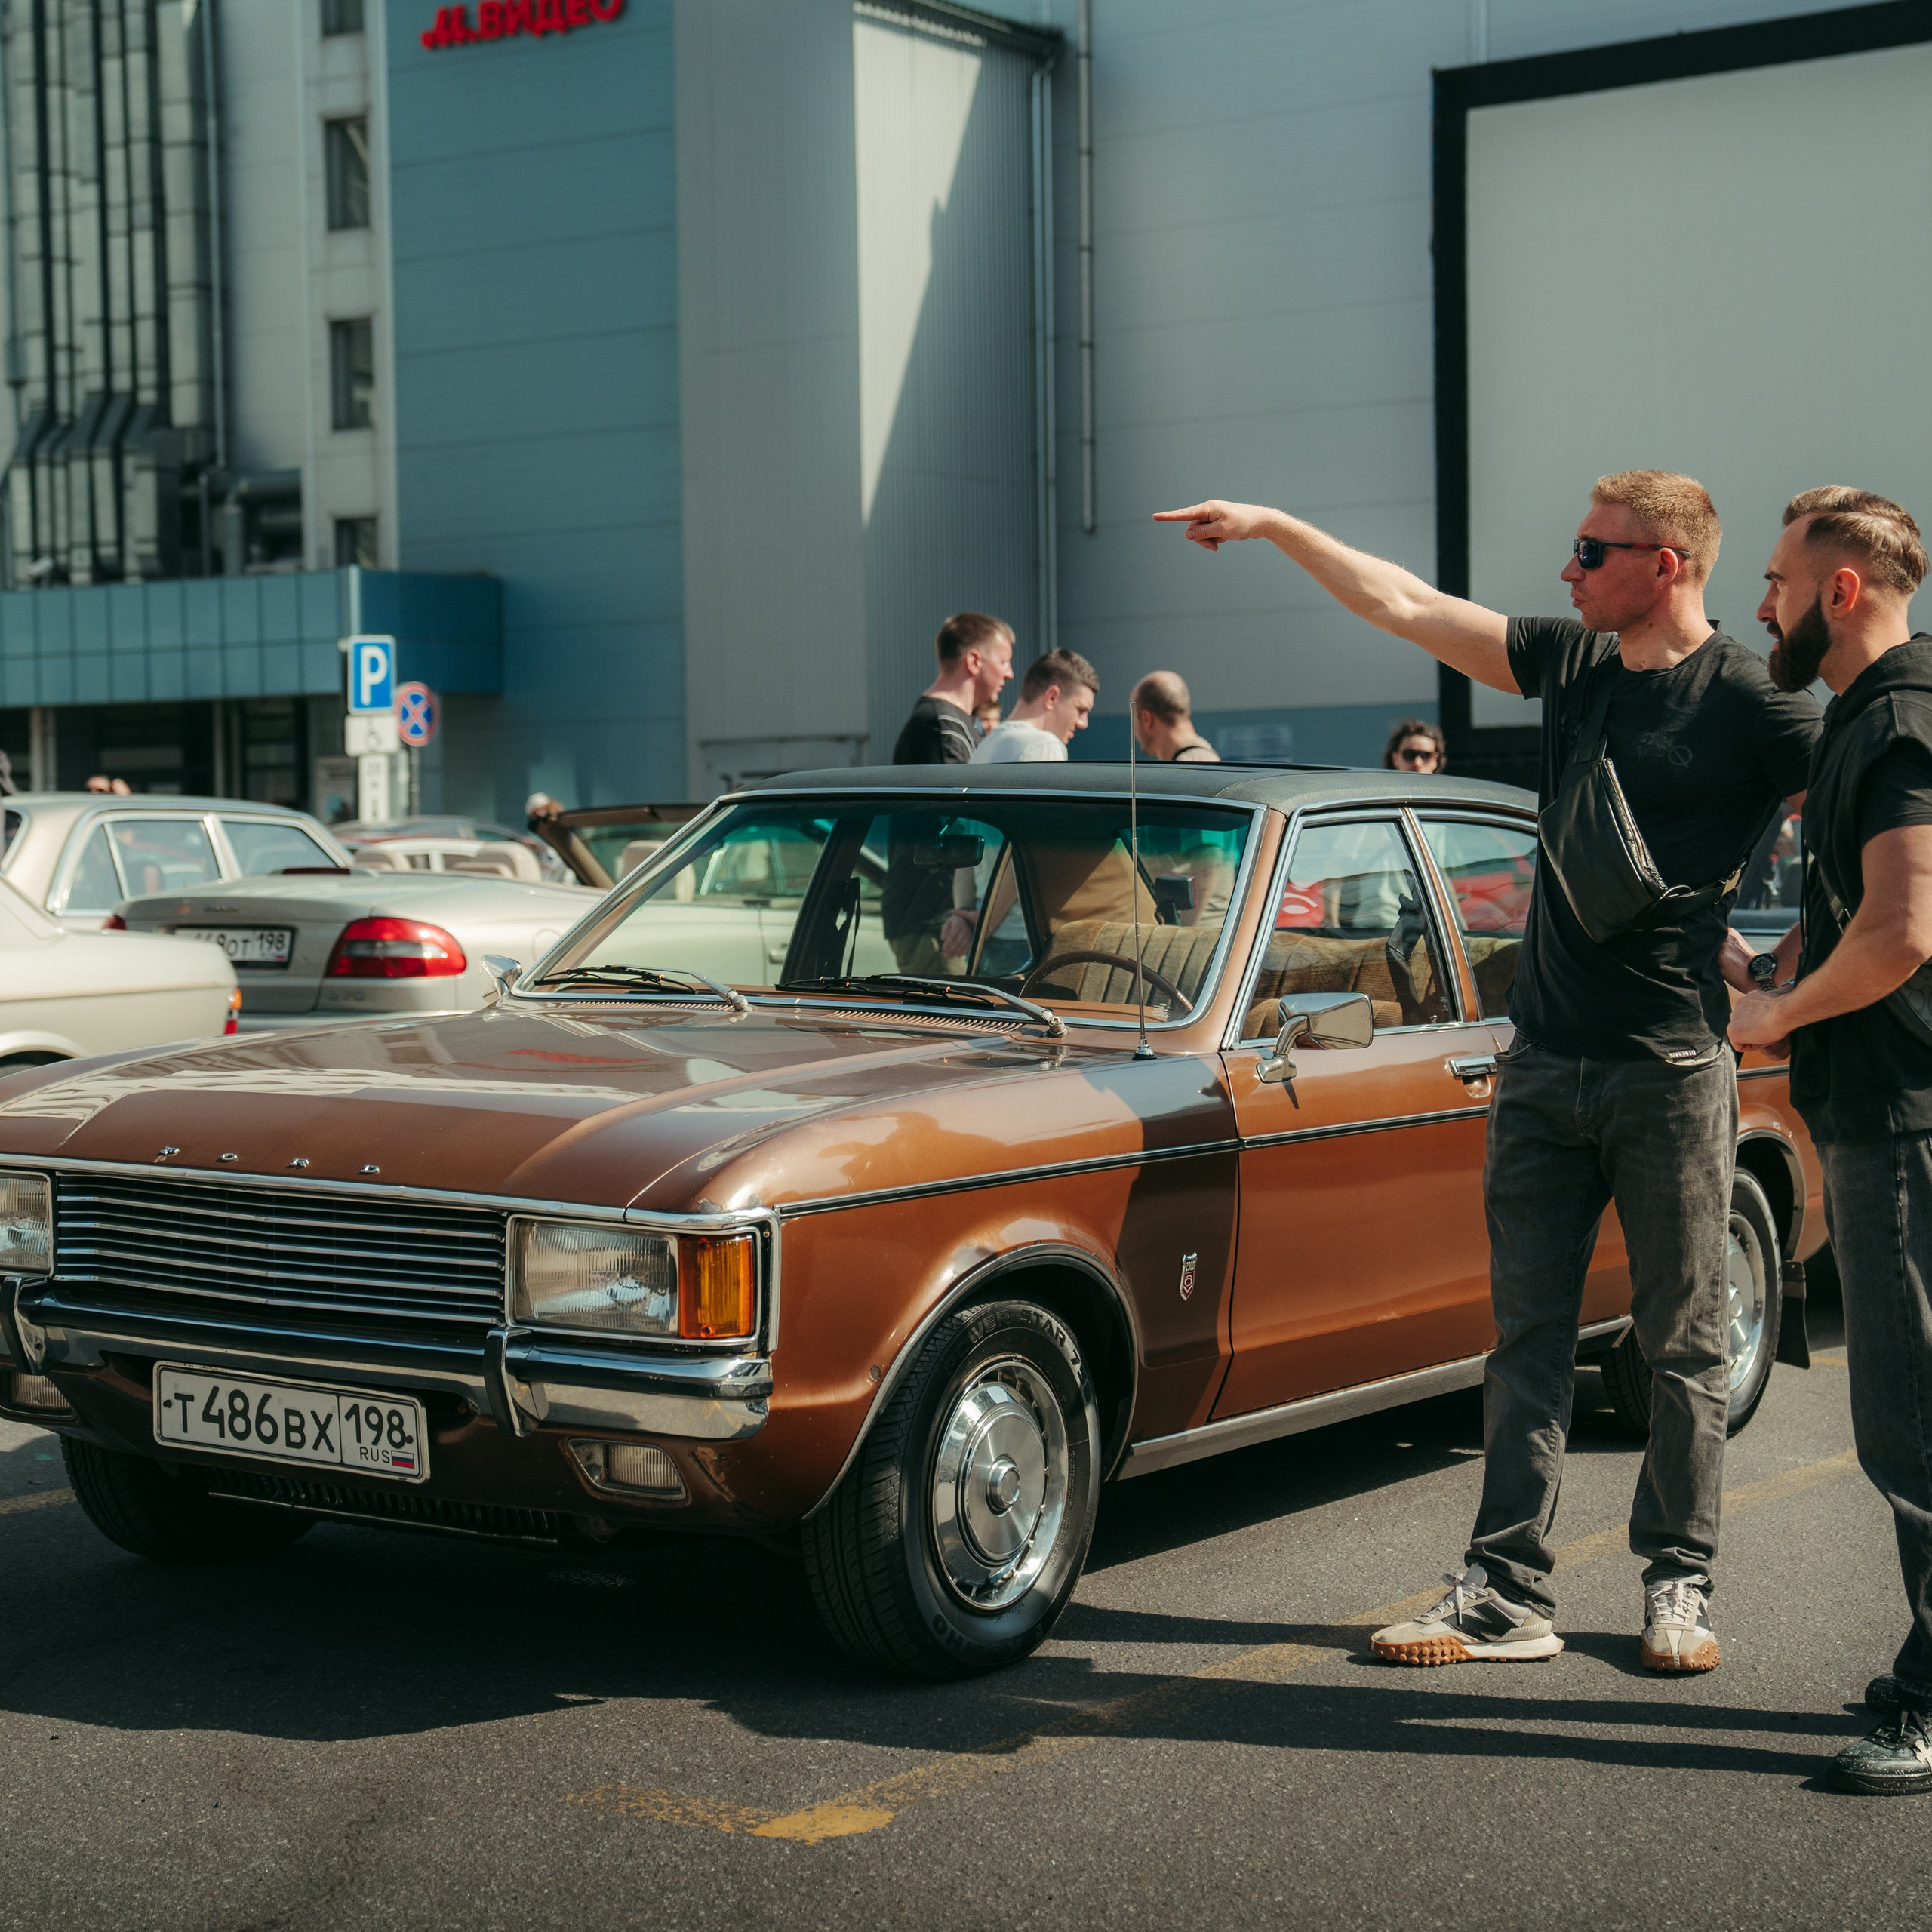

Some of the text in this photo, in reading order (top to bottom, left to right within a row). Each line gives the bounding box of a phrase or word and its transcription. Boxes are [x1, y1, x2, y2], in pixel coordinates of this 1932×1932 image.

[360, 645, 388, 706] P
[257, 932, 285, 952] 198
[159, 1146, 380, 1174] FORD
[1185, 1275, 1192, 1287] 6
[1019, 1309, 1066, 1349] STAR
[174, 1386, 406, 1454] Т486ВХ 198
[360, 1446, 390, 1464] RUS
